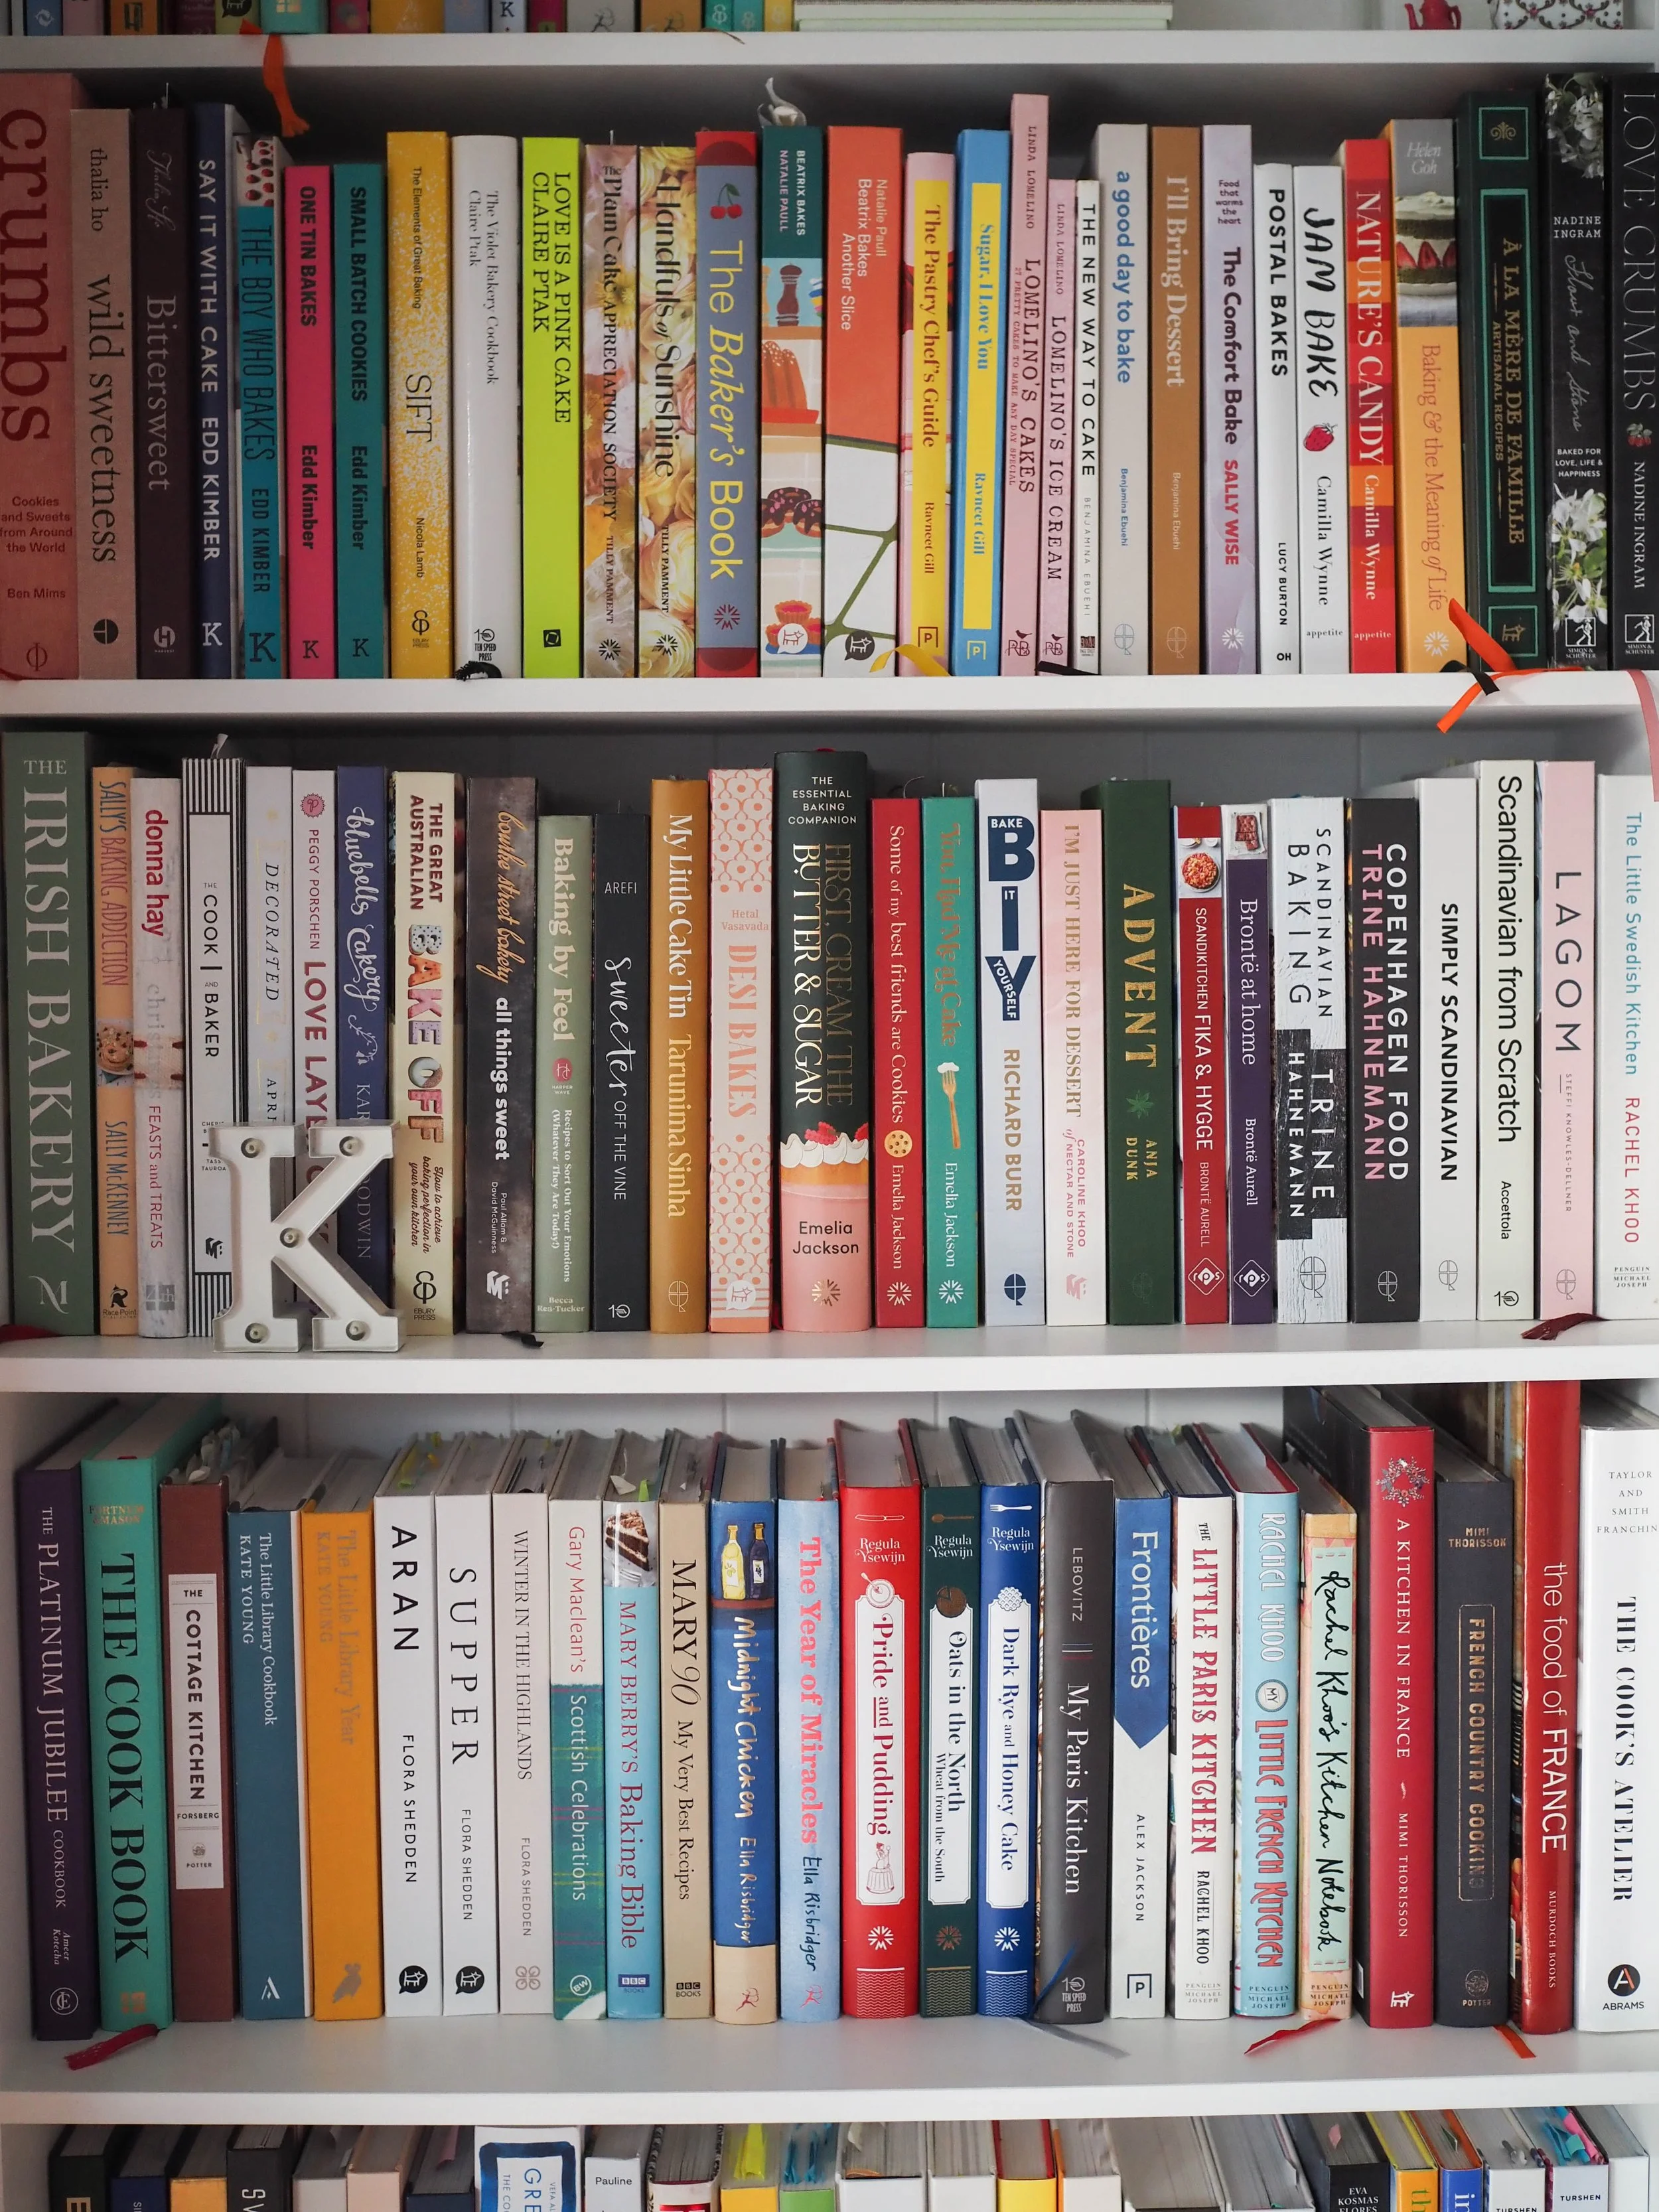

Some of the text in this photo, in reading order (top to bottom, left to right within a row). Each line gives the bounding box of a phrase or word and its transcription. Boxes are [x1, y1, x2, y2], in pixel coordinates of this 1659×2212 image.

[1407, 142, 1442, 157] Helen
[1412, 160, 1439, 175] Goh
[1553, 216, 1601, 225] NADINE
[0, 110, 66, 441] crumbs
[199, 160, 218, 392] SAY IT WITH CAKE
[300, 185, 317, 327] ONE TIN BAKES
[351, 188, 367, 401] SMALL BATCH COOKIES
[483, 190, 499, 384] The Violet Bakery Cookbook
[533, 173, 549, 332] CLAIRE PTAK
[554, 173, 571, 422] LOVE IS A PINK CAKE
[976, 225, 993, 278] Sugar,
[1112, 171, 1135, 383] a good day to bake
[1269, 190, 1287, 376] POSTAL BAKES
[1553, 229, 1601, 238] INGRAM
[1624, 94, 1656, 409] LOVE CRUMBS
[977, 338, 993, 371] You
[979, 295, 993, 333] Love
[1019, 259, 1041, 492] LOMELINO'S CAKES
[1082, 204, 1095, 475] THE NEW WAY TO CAKE
[88, 274, 125, 562] wild sweetness
[147, 296, 177, 490] Bittersweet
[405, 374, 432, 442] SIFT
[709, 240, 745, 579] The Baker's Book
[202, 418, 220, 560] EDD KIMBER
[303, 446, 318, 549] Edd Kimber
[974, 474, 985, 553] Ravneet Gill
[1313, 476, 1333, 605] Camilla Wynne
[1634, 462, 1644, 588] NADINE INGRAM
[416, 551, 425, 578] Lamb
[1306, 628, 1343, 639] appetite
[24, 761, 66, 774] THE
[788, 816, 856, 824] COMPANION
[792, 790, 852, 798] ESSENTIAL
[812, 776, 833, 785] THE
[142, 810, 167, 936] donna hay
[411, 795, 423, 909] AUSTRALIAN
[429, 803, 443, 903] THE GREAT
[605, 882, 636, 893] AREFI
[204, 895, 218, 954] COOK
[548, 838, 576, 1041] Baking by Feel
[793, 844, 822, 1108] BUTTER & SUGAR
[1123, 884, 1156, 1067] ADVENT
[1241, 899, 1261, 1065] Brontë at home
[1555, 872, 1581, 1051] LAGOM
[25, 787, 74, 1252] IRISH BAKERY
[205, 994, 219, 1057] BAKER
[408, 925, 446, 1142] BAKE OFF
[490, 997, 511, 1160] all things sweet
[729, 945, 757, 1117] DESI BAKES
[1387, 844, 1408, 1179] COPENHAGEN FOOD
[1441, 904, 1458, 1180] SIMPLY SCANDINAVIAN
[614, 1101, 626, 1199] OFF THE VINE
[1004, 1050, 1021, 1211] RICHARD BURR
[1624, 1098, 1640, 1242] RACHEL KHOO
[210, 1120, 405, 1353] K
[793, 1241, 858, 1254] Jackson
[800, 1221, 852, 1234] Emelia
[1502, 1181, 1511, 1239] Accettola
[392, 1526, 419, 1649] ARAN
[566, 1527, 587, 1672] Gary Maclean's
[855, 1550, 905, 1565] Ysewijn
[861, 1538, 899, 1550] Regula
[1072, 1548, 1082, 1621] LEBOVITZ
[1131, 1532, 1158, 1688] Frontières
[186, 1610, 204, 1799] COTTAGE KITCHEN
[450, 1568, 478, 1764] SUPPER
[1397, 1519, 1410, 1757] A KITCHEN IN FRANCE
[101, 1554, 149, 1964] THE COOK BOOK
[403, 1735, 416, 1881] FLORA SHEDDEN
[1060, 1684, 1089, 1894] My Paris Kitchen
[1603, 2001, 1644, 2010] ABRAMS
[595, 2177, 632, 2185] Pauline
[1337, 2196, 1379, 2205] KOSMAS
